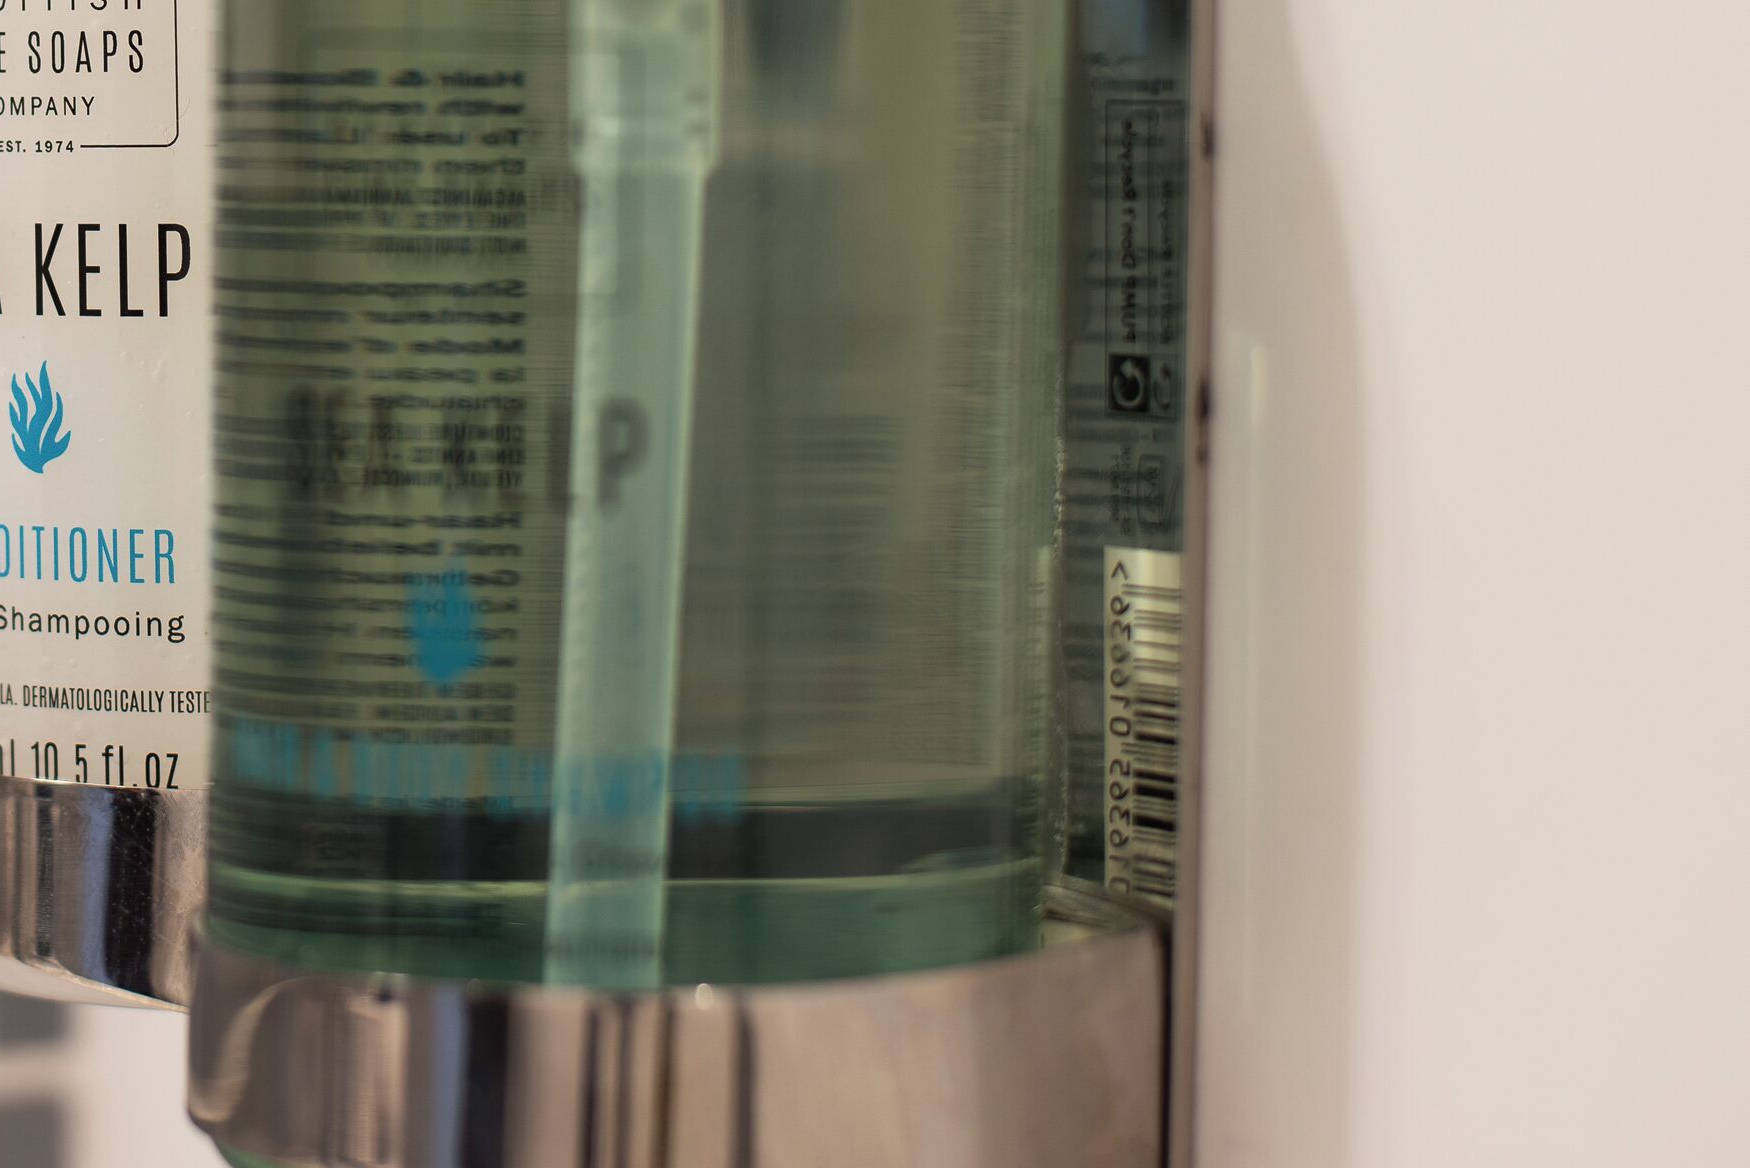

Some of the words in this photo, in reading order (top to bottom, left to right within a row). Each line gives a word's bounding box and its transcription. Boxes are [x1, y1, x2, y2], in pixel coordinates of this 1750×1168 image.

[27, 29, 144, 74] SOAPS
[35, 140, 75, 153] 1974
[34, 223, 191, 317] KELP
[23, 684, 164, 713] DERMATOLOGICALLY
[169, 690, 211, 714] TESTE
[30, 741, 88, 784] 105
